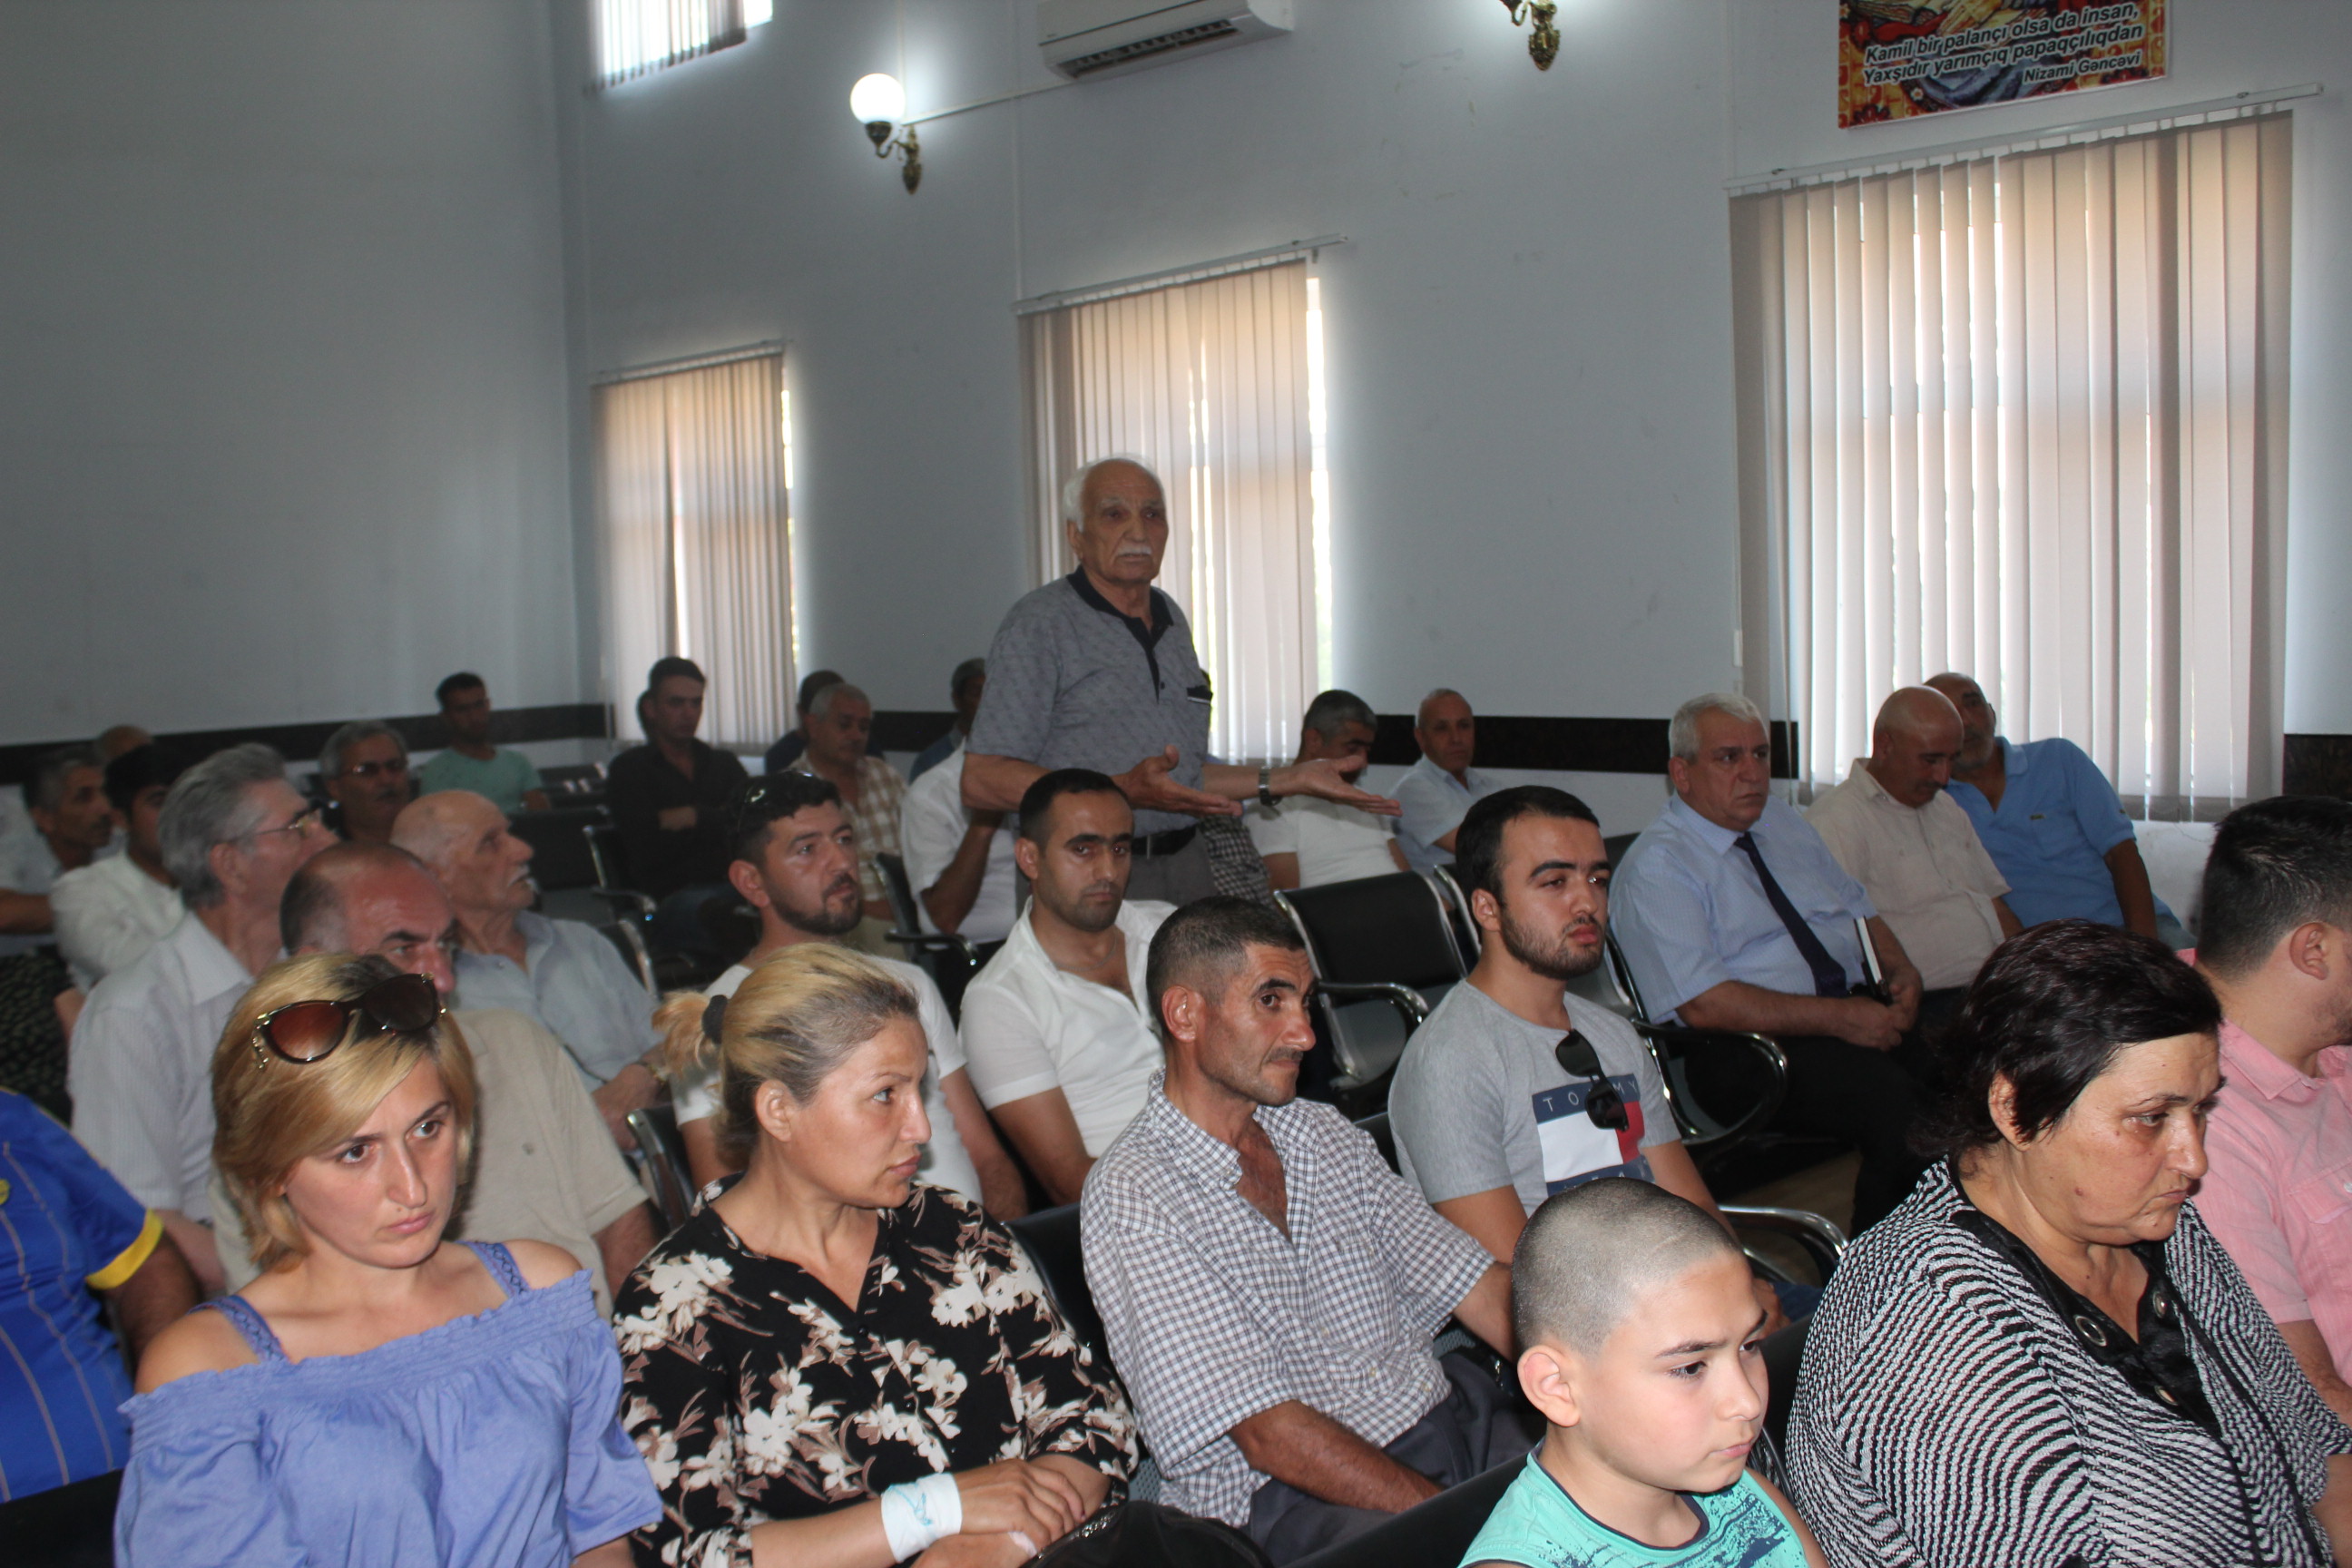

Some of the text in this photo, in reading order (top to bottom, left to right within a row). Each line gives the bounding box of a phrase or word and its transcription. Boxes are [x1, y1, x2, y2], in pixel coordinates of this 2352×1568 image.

[1864, 24, 2143, 83] Yaxşıdır yarımçıq papaqçılıqdan
[1866, 4, 2139, 64] Kamil bir palançı olsa da insan,
[2024, 51, 2141, 83] Nizami Gəncəvi
[1543, 1080, 1639, 1112] TOMY
